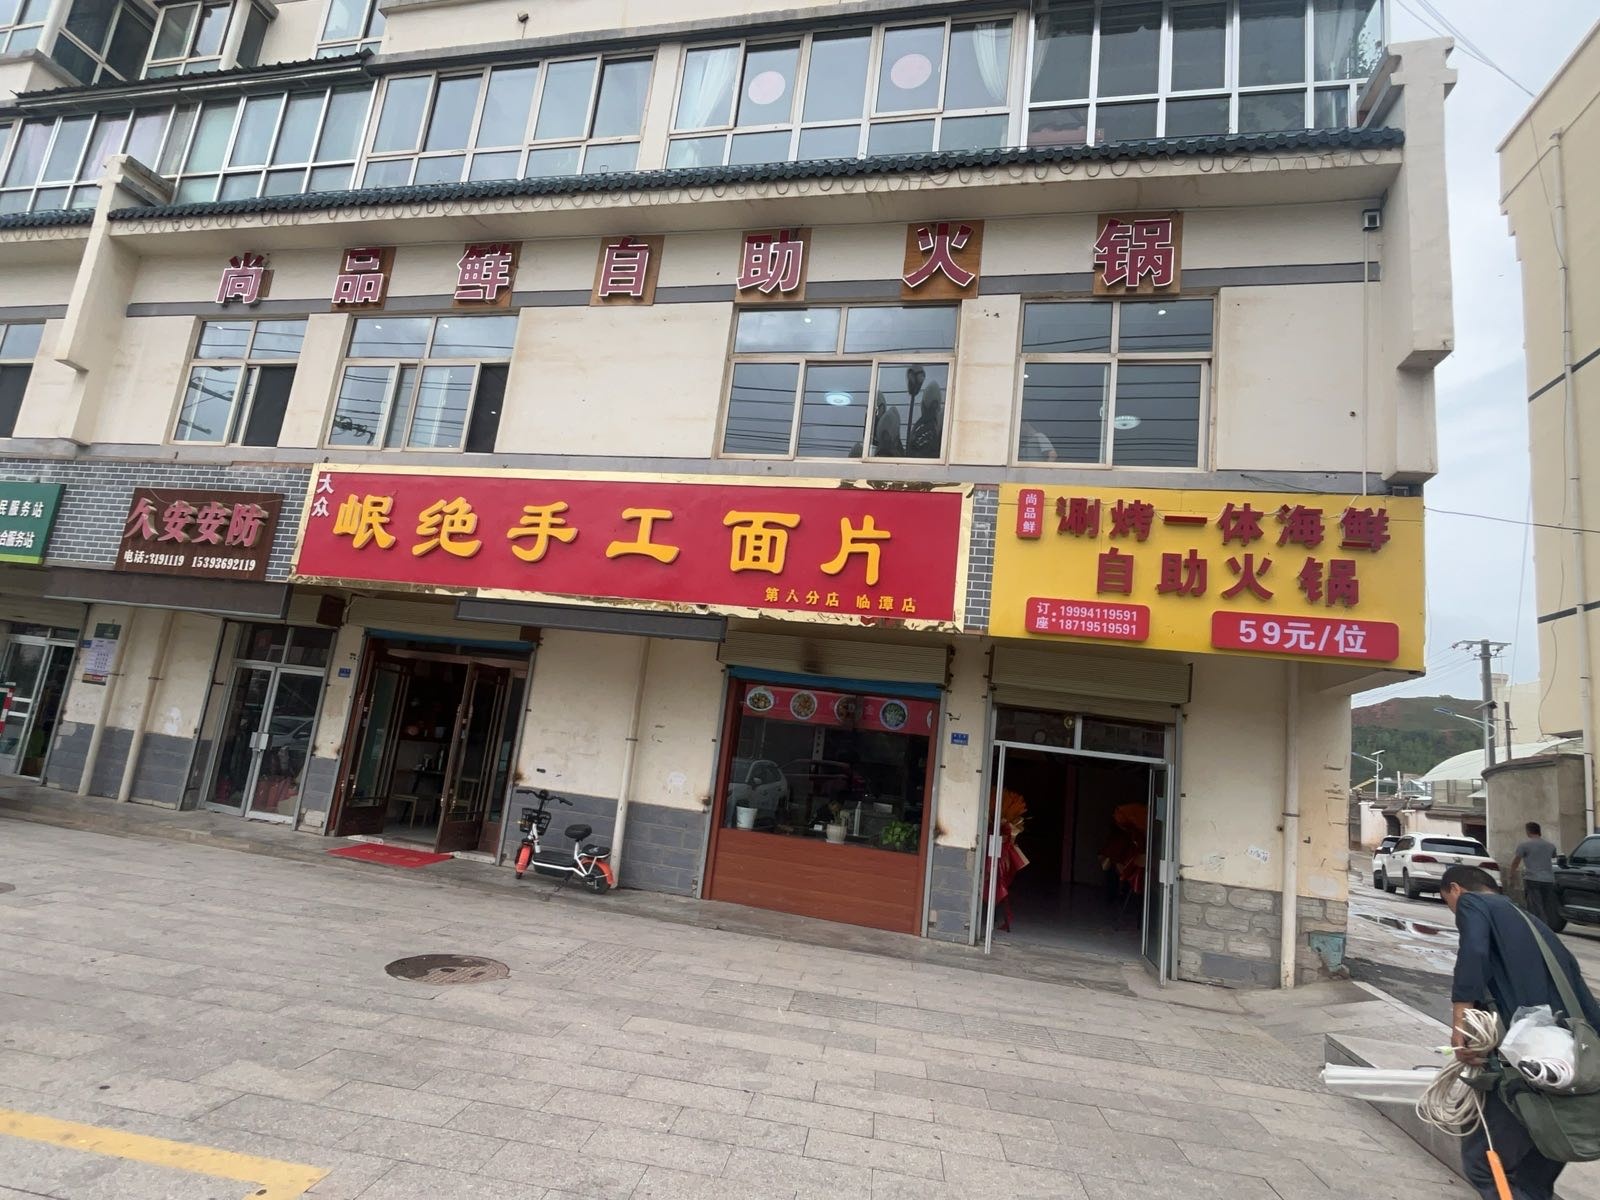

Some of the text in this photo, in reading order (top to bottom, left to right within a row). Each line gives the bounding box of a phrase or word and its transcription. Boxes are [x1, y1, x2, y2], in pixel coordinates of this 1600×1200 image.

[216, 216, 1177, 307] 尚品鲜自助火锅
[311, 473, 335, 517] 大众
[1022, 493, 1038, 533] 尚品鲜
[124, 497, 269, 547] 久安安防
[333, 493, 891, 586] 岷绝手工面片
[1056, 496, 1391, 551] 涮烤一体海鲜
[123, 549, 256, 571] 电话:3191119 15393692119
[1096, 547, 1360, 608] 自助火锅
[856, 594, 916, 612] 临潭店
[1059, 605, 1137, 622] 19994119591
[1058, 619, 1136, 636] 18719519591
[1239, 619, 1368, 654] 59元/位
